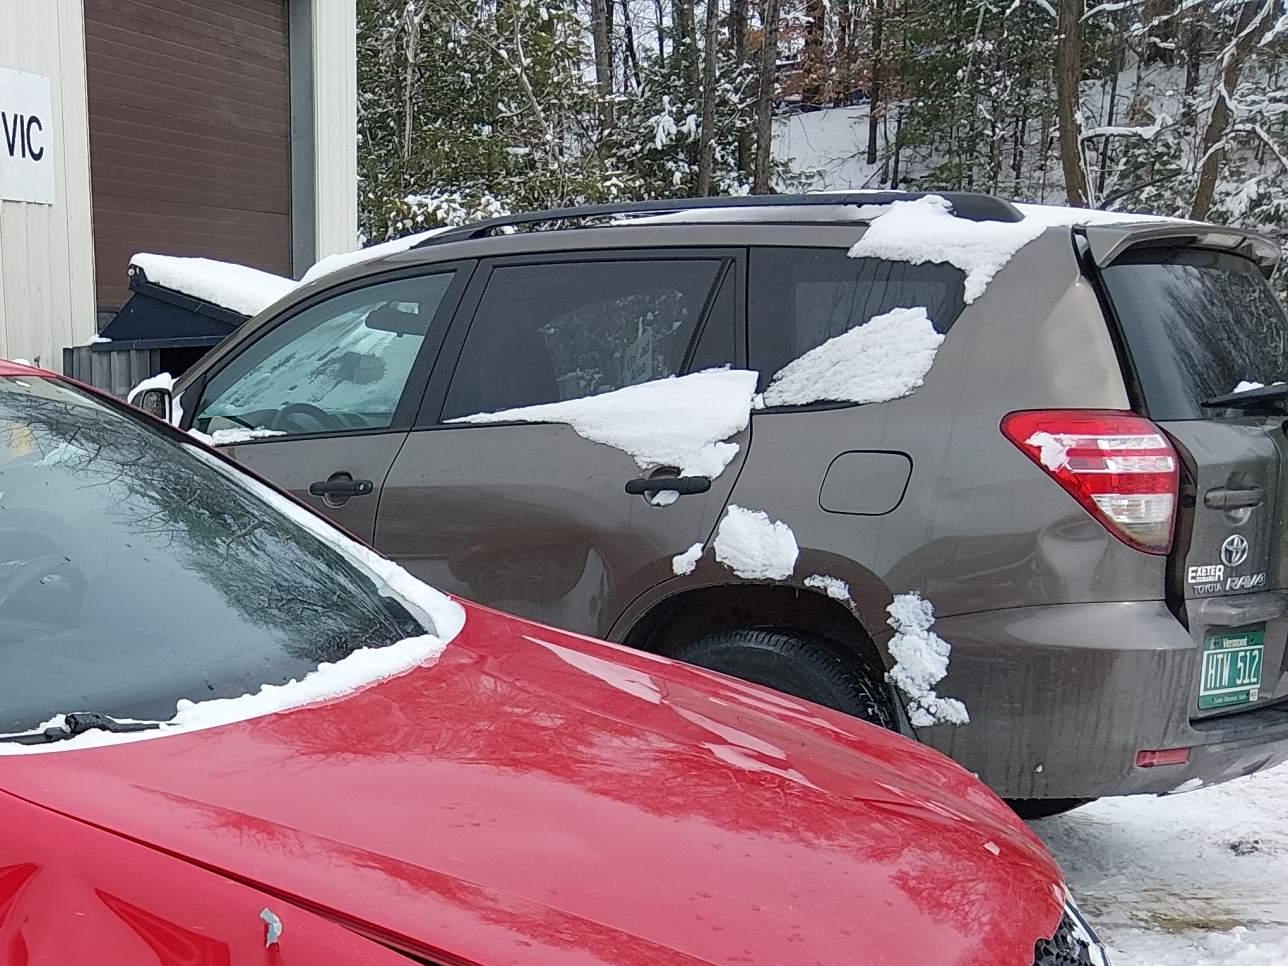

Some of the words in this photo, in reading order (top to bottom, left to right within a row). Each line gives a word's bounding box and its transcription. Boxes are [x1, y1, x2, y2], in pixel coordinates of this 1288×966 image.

[1, 111, 44, 161] VIC
[1188, 565, 1224, 583] EXETER
[1193, 583, 1222, 594] TOYOTA
[1226, 572, 1265, 591] RAV4
[1223, 636, 1247, 648] Vermont
[1207, 653, 1231, 689] HTW
[1236, 650, 1259, 685] 512
